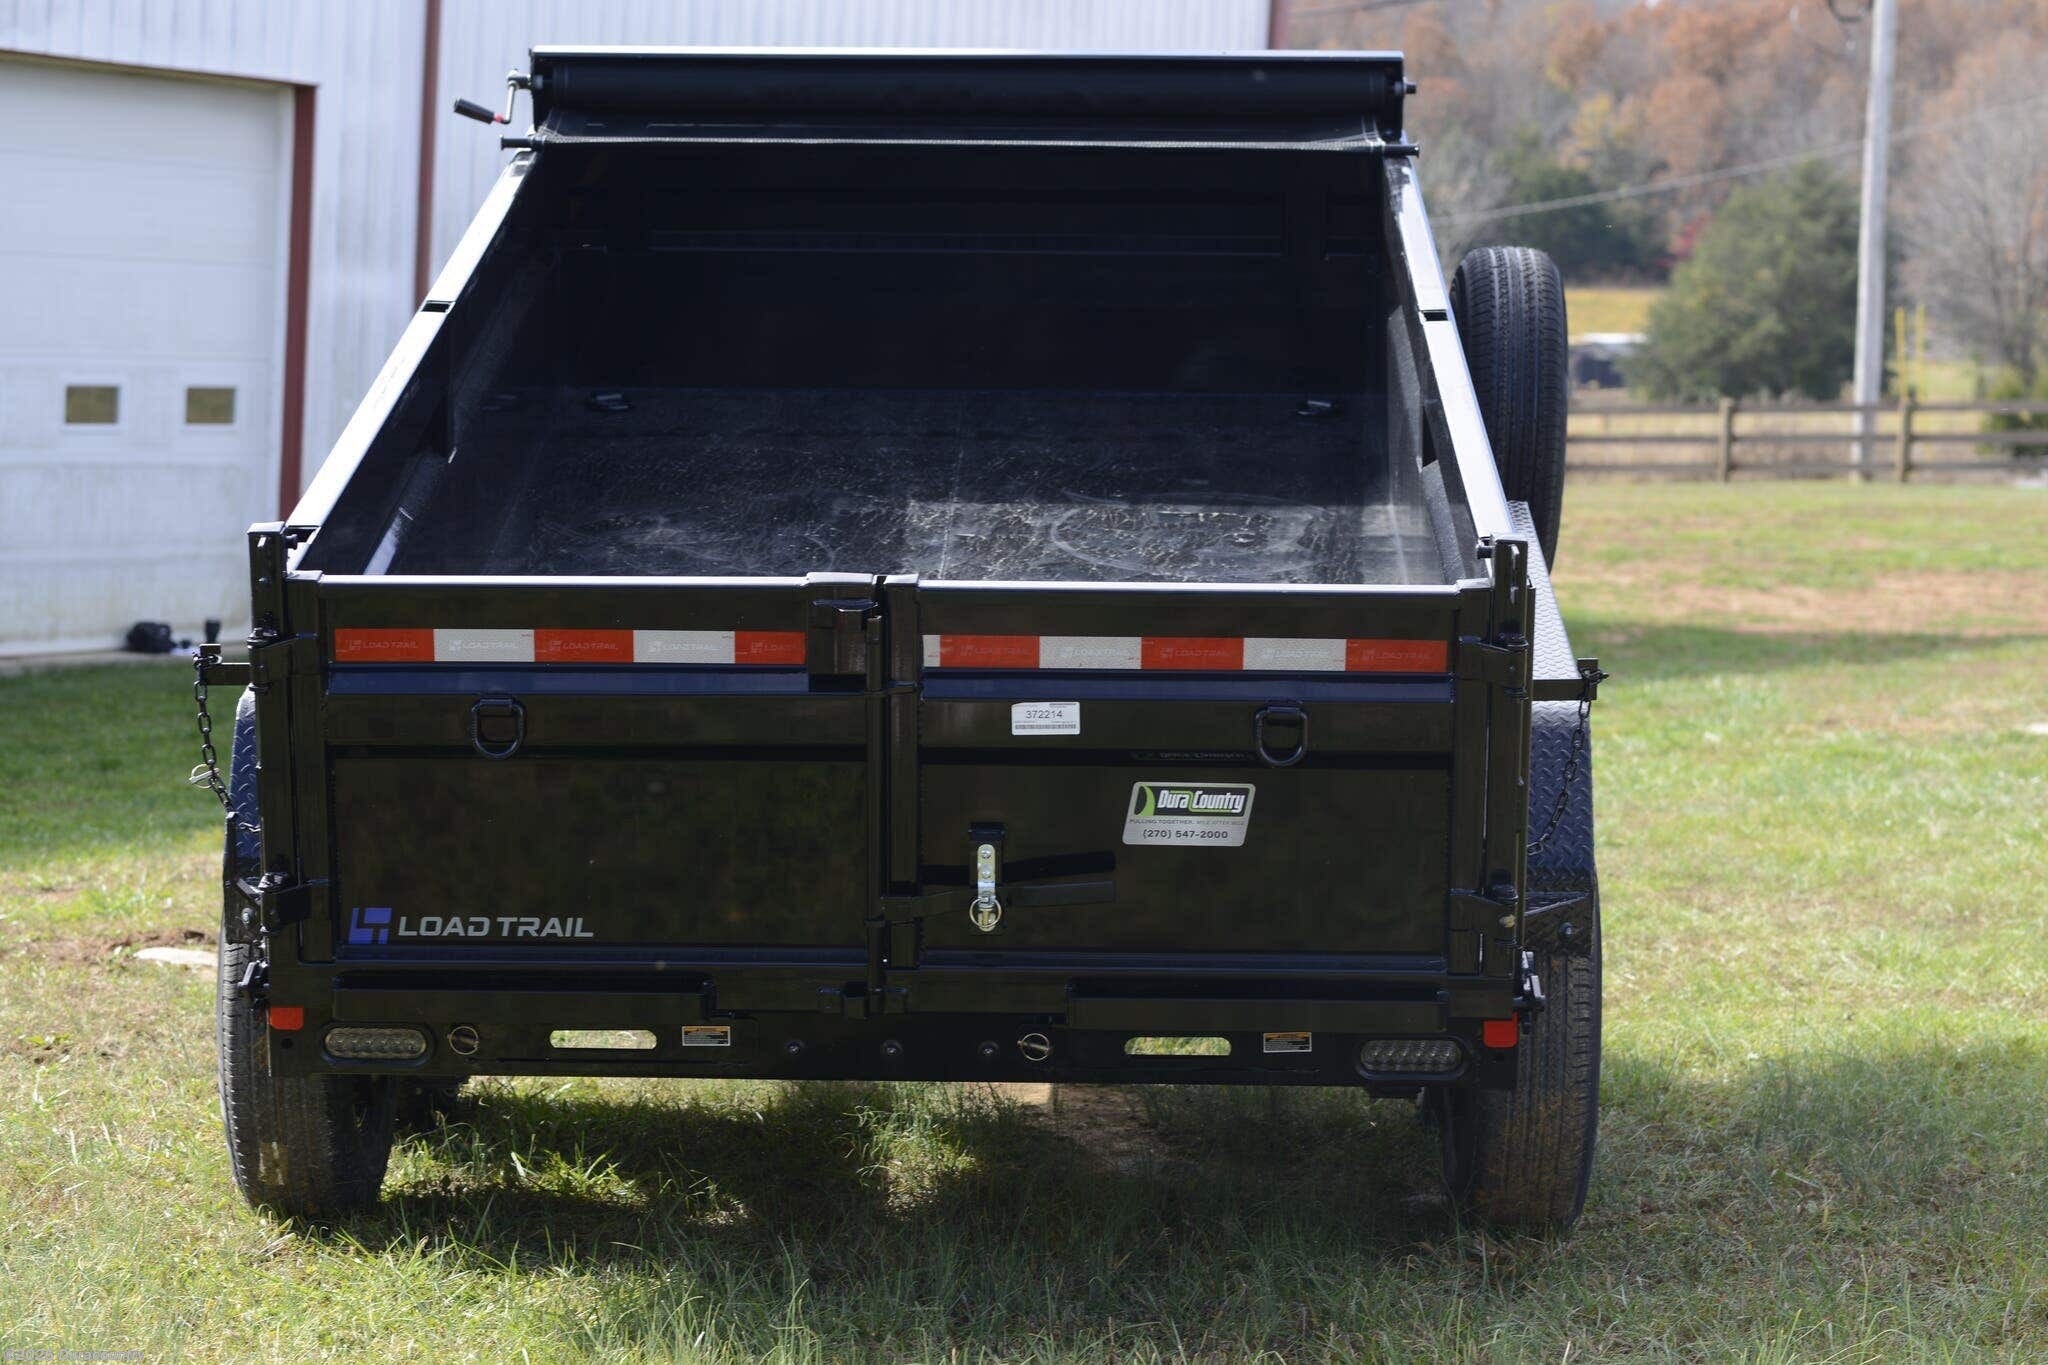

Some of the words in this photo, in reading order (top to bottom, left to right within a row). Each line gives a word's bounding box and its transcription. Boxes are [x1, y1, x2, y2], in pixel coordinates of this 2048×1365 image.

[1025, 710, 1063, 719] 372214
[1157, 789, 1188, 809] Dura
[1192, 790, 1246, 814] Country
[1143, 829, 1172, 839] (270)
[1175, 830, 1229, 839] 547-2000
[398, 916, 490, 937] LOAD
[496, 917, 594, 938] TRAIL
